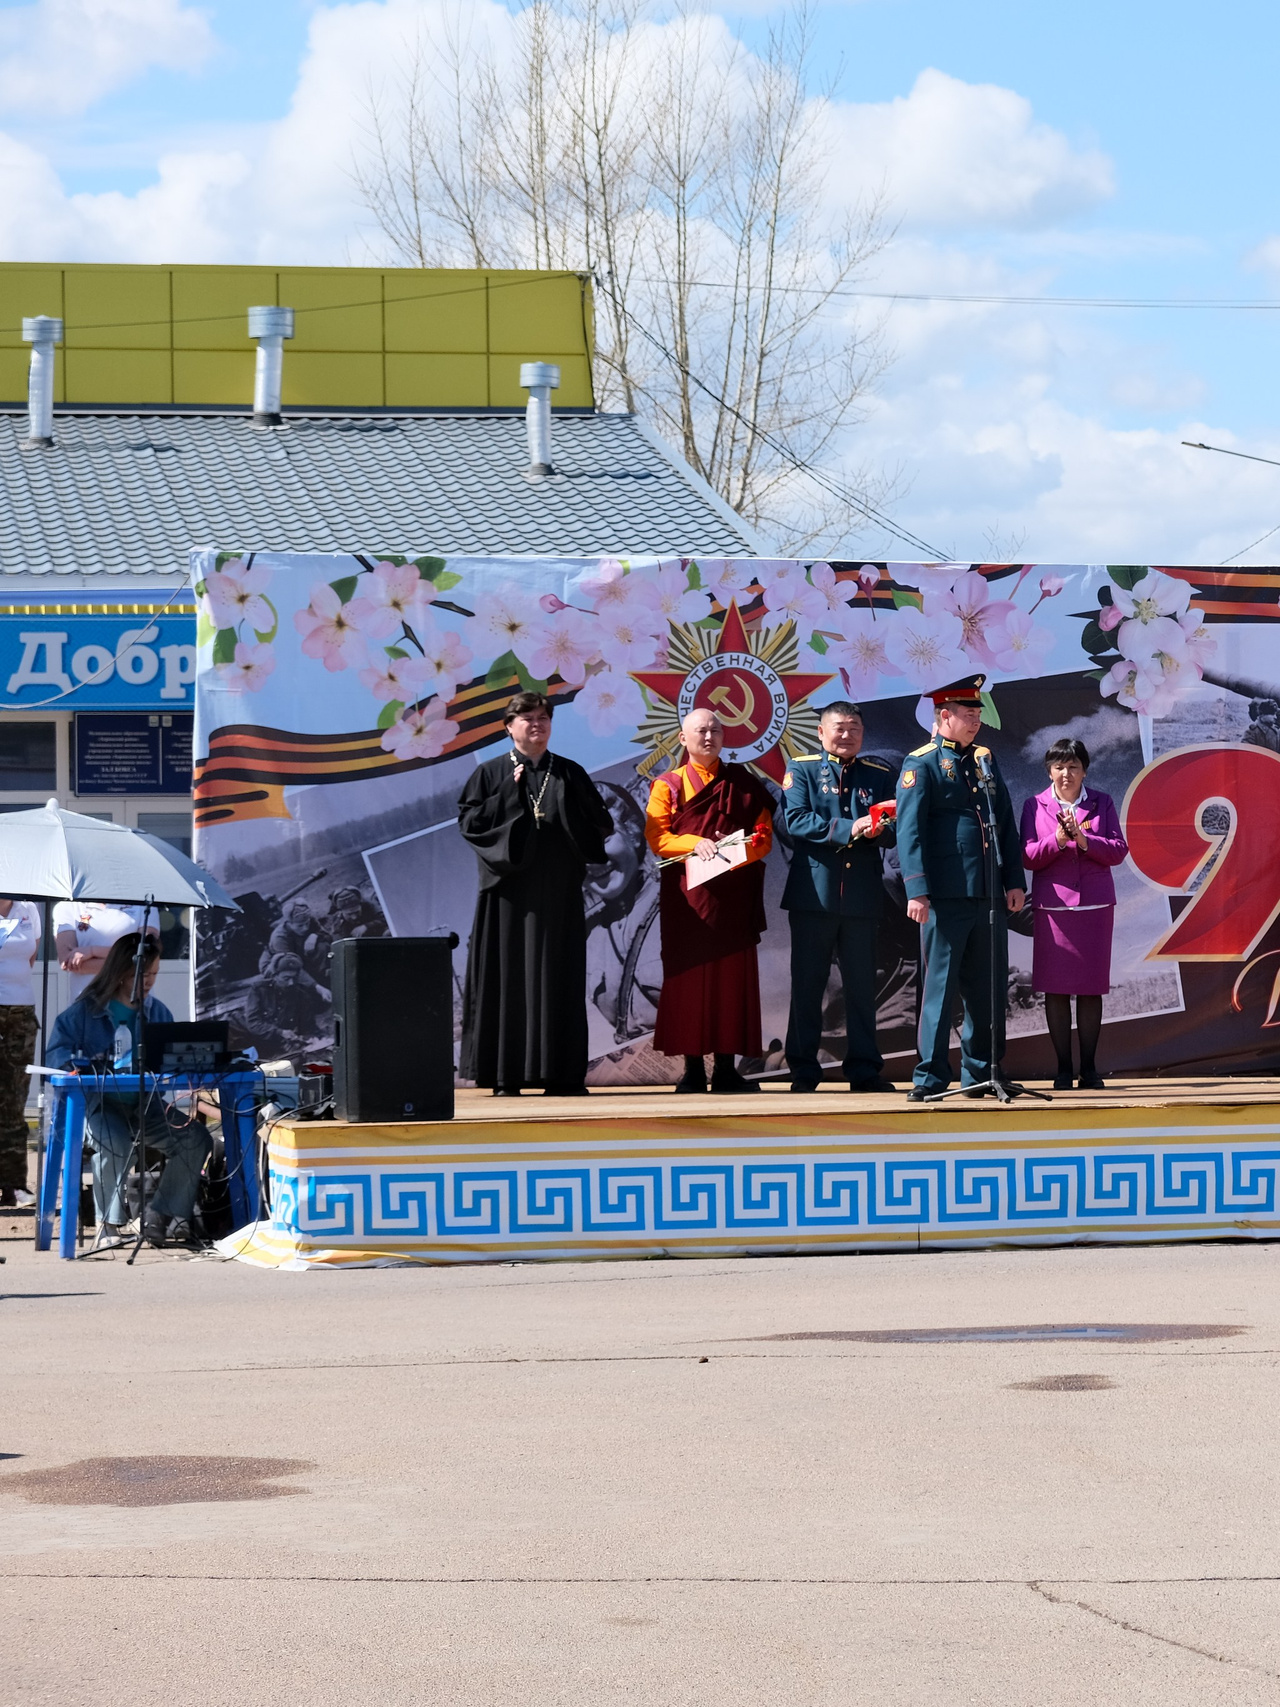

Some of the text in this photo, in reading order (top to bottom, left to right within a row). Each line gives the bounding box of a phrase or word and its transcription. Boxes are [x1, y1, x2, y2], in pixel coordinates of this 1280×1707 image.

[6, 625, 197, 699] Добр
[680, 654, 787, 753] ЧЕСТВЕННАЯ ВОЙНА
